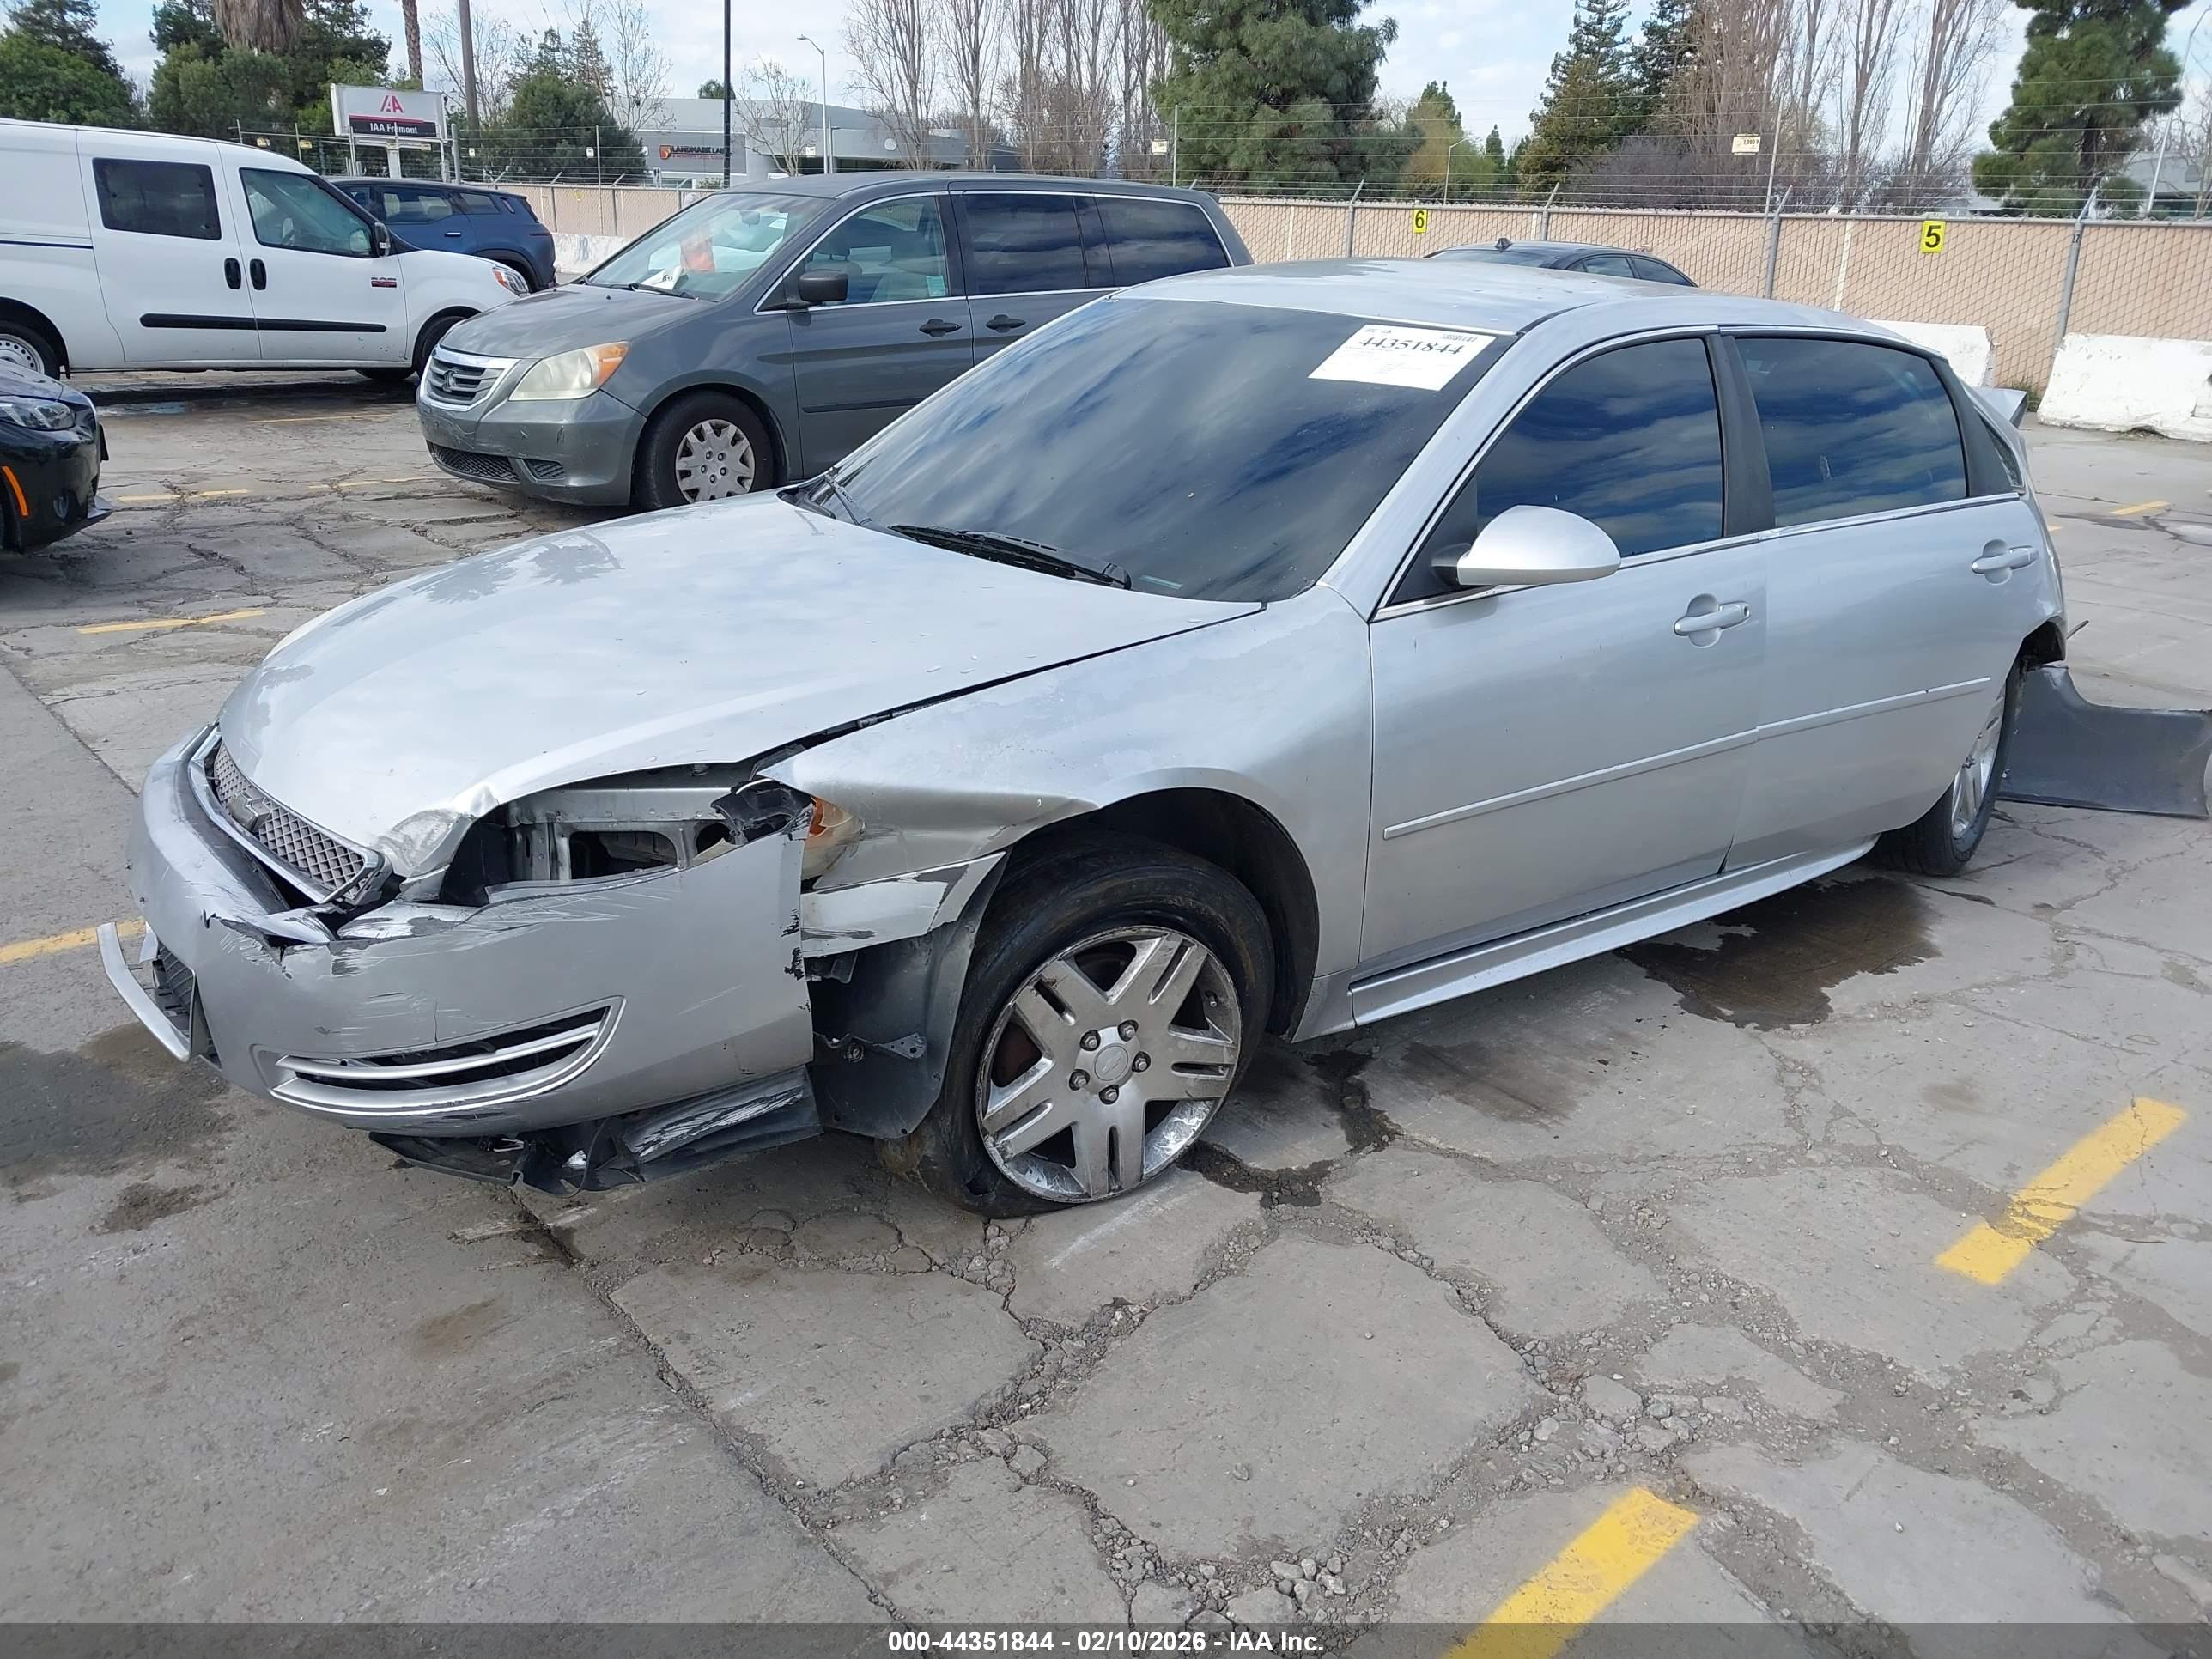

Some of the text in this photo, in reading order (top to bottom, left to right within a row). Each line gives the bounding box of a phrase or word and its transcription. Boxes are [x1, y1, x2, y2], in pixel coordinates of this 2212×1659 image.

[369, 123, 418, 134] IAA Fremont
[1415, 210, 1425, 229] 6
[1925, 224, 1941, 248] 5
[1358, 337, 1465, 355] 44351844
